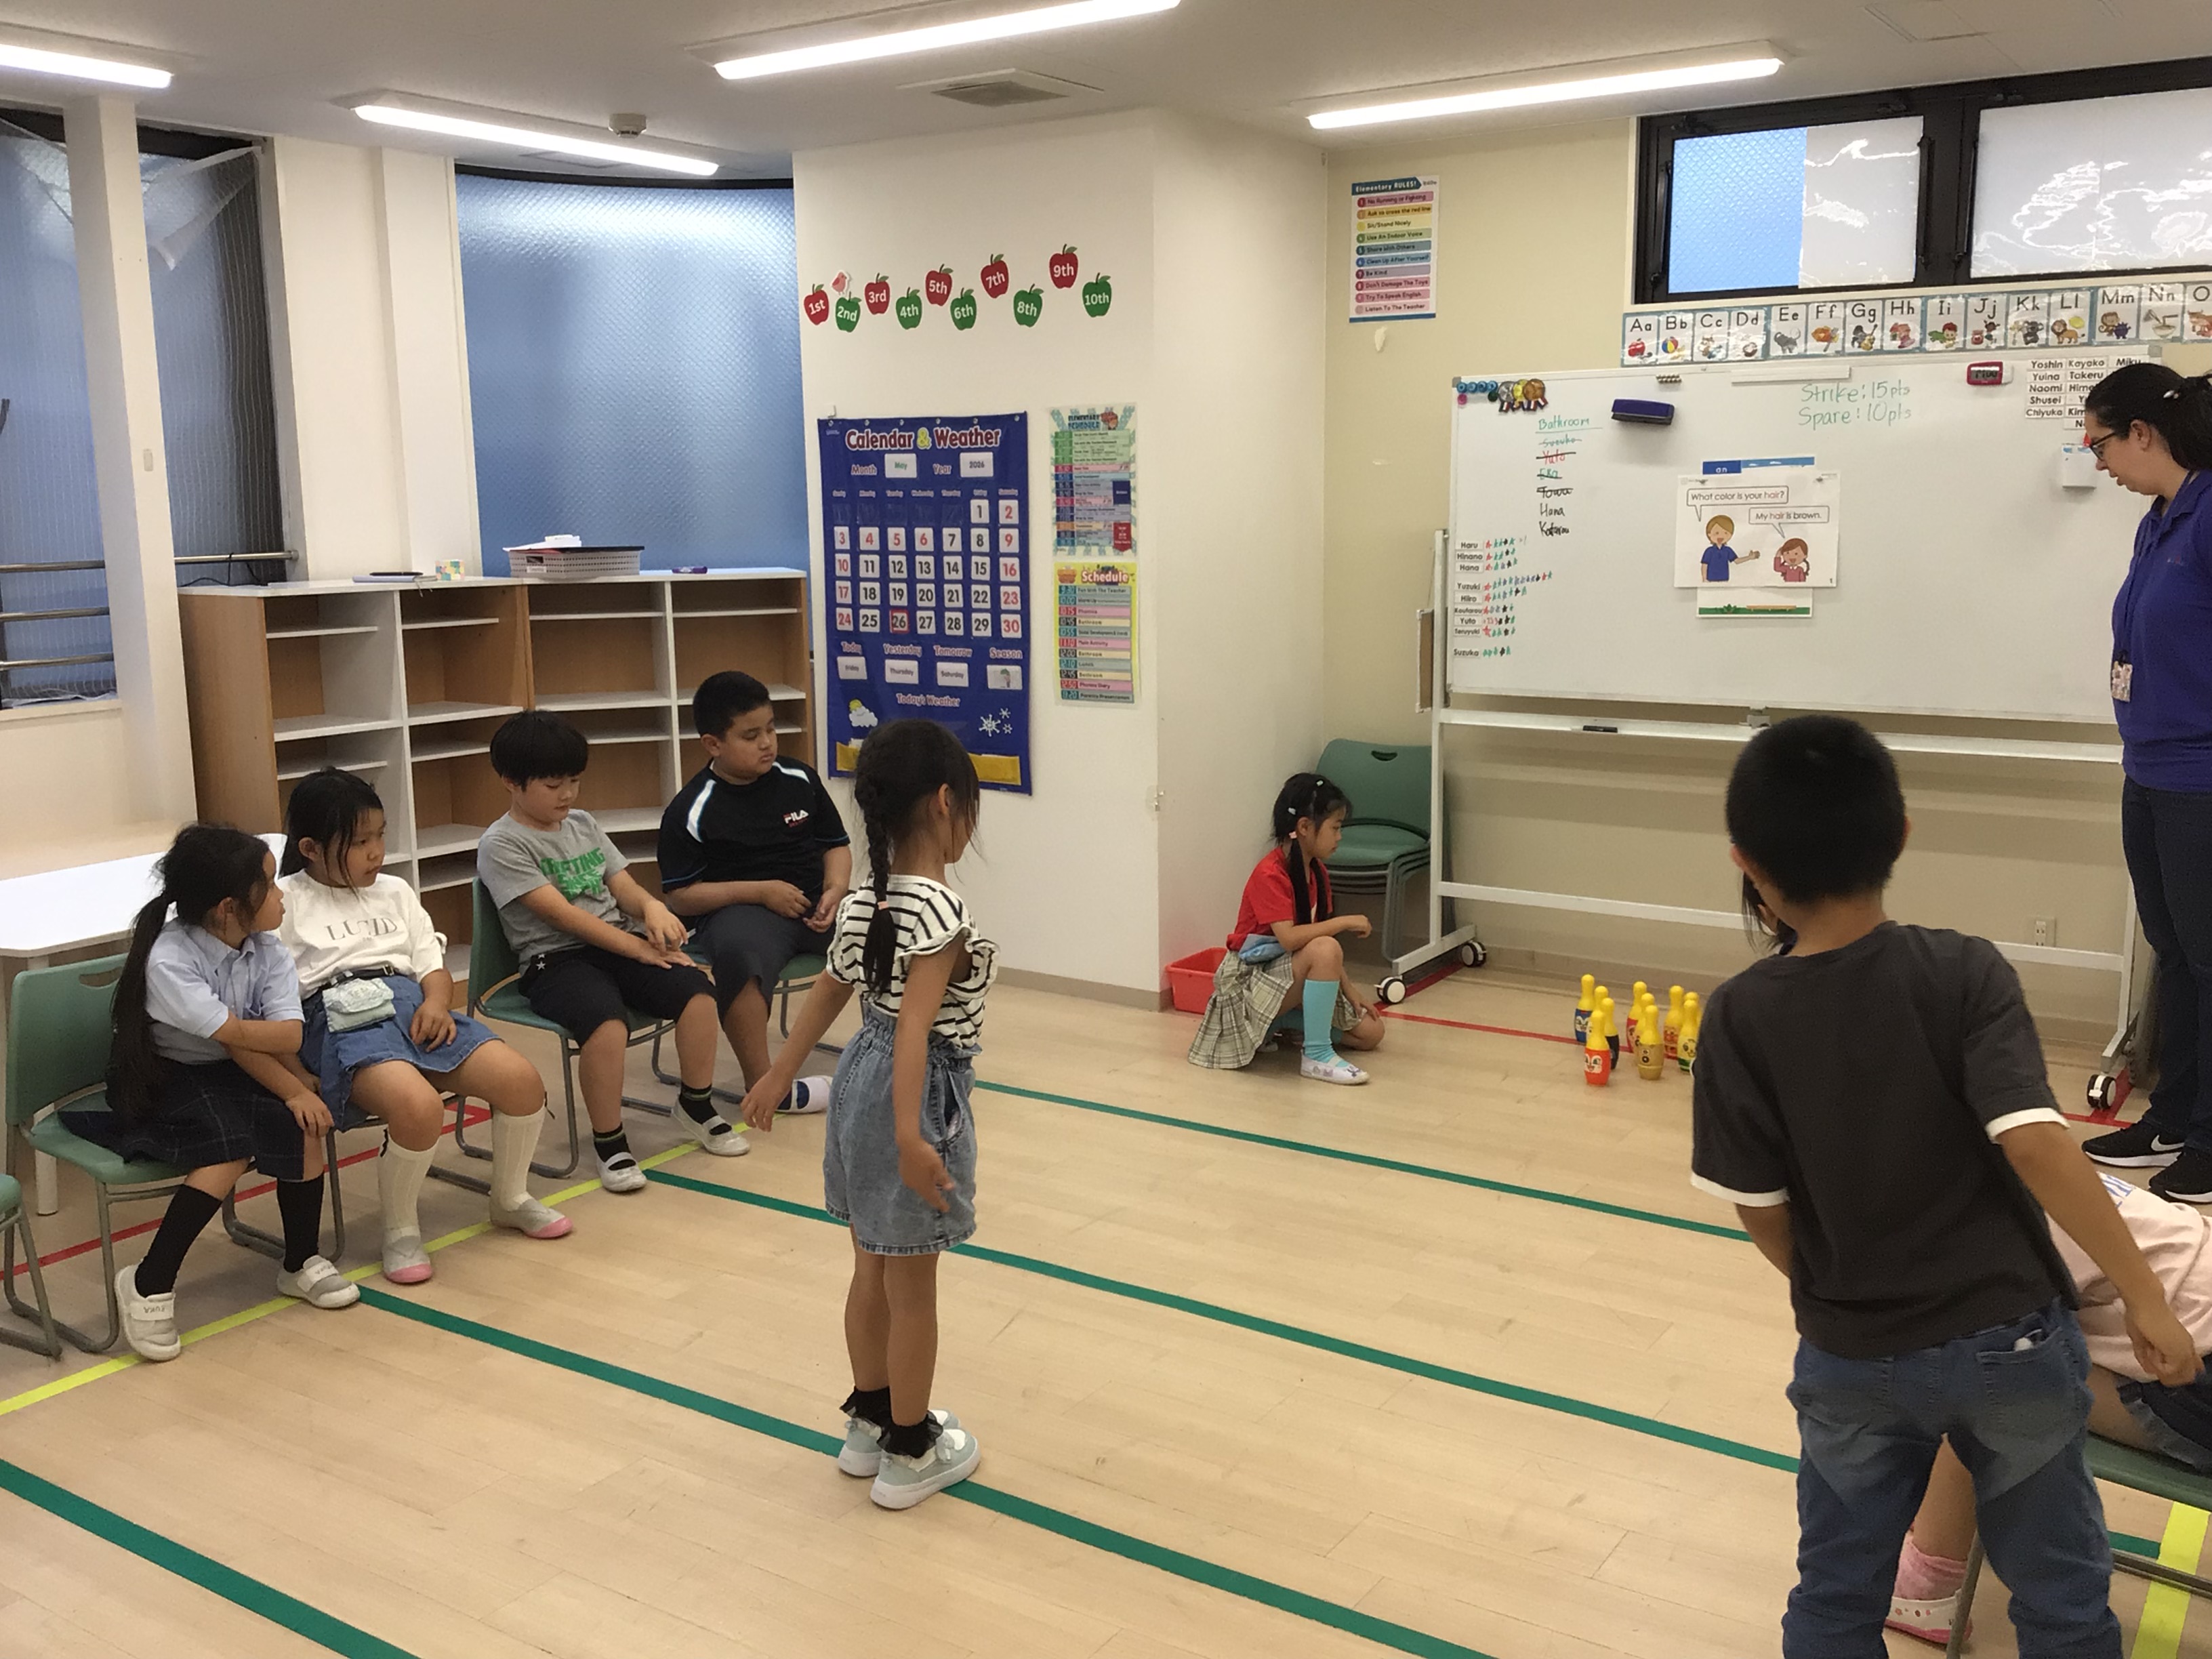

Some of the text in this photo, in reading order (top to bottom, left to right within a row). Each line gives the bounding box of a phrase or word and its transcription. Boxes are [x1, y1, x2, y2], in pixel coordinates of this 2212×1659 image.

[1053, 263, 1074, 277] 9th
[929, 280, 947, 294] 5th
[986, 272, 1006, 289] 7th
[868, 289, 886, 303] 3rd
[1084, 292, 1109, 306] 10th
[2060, 293, 2079, 310] Ll
[2102, 290, 2134, 305] Mm
[2148, 287, 2175, 302] Nn
[808, 299, 825, 315] 1st
[1017, 302, 1037, 316] 8th
[1890, 300, 1914, 316] Hh
[1938, 300, 1950, 315] Ii
[1974, 298, 1996, 319] Jj
[2017, 296, 2040, 311] Kk
[837, 306, 857, 322] 2nd
[900, 306, 919, 318] 4th
[954, 304, 974, 319] 6th
[1736, 310, 1759, 326] Dd
[1779, 307, 1799, 321] Ee
[1816, 304, 1837, 319] Ff
[1851, 304, 1876, 323] Gg
[1630, 318, 1652, 332] Aa
[1665, 316, 1687, 330] Bb
[1700, 314, 1723, 328] Cc
[2031, 361, 2063, 369] Yoshin
[2068, 359, 2104, 370] Kayako
[2069, 371, 2104, 380] Takeru
[1801, 382, 1866, 403] Strike:
[2029, 384, 2063, 392] Naomi
[2030, 396, 2062, 404] Shusei
[1798, 407, 1860, 431] Spare:
[2026, 409, 2063, 417] Chiyuka
[1538, 415, 1589, 430] Bathroom
[846, 426, 1001, 450] Calendar & Weather
[851, 464, 877, 476] Month
[895, 461, 907, 470] May
[933, 464, 951, 475] Year
[1691, 493, 1713, 501] What
[1764, 491, 1785, 499] hair?
[977, 506, 1012, 519] 1 2
[1540, 503, 1565, 517] Hana
[839, 533, 1012, 547] 3 4 5 6 7 8 9
[838, 560, 1017, 576] 10 11 12 13 14 15 16
[1081, 570, 1130, 583] Schedule
[838, 586, 1019, 605] 17 18 19 20 21 22 23
[838, 613, 1019, 633] 24 25 26 27 28 29 30
[841, 642, 1023, 659] Today Yesterday Tomorrow Season
[1454, 649, 1479, 657] Suzuka
[890, 668, 914, 676] Thursday
[941, 670, 964, 679] Saturday
[896, 693, 960, 707] Today's Weather
[784, 809, 808, 824] FILA
[324, 918, 398, 941] LUID
